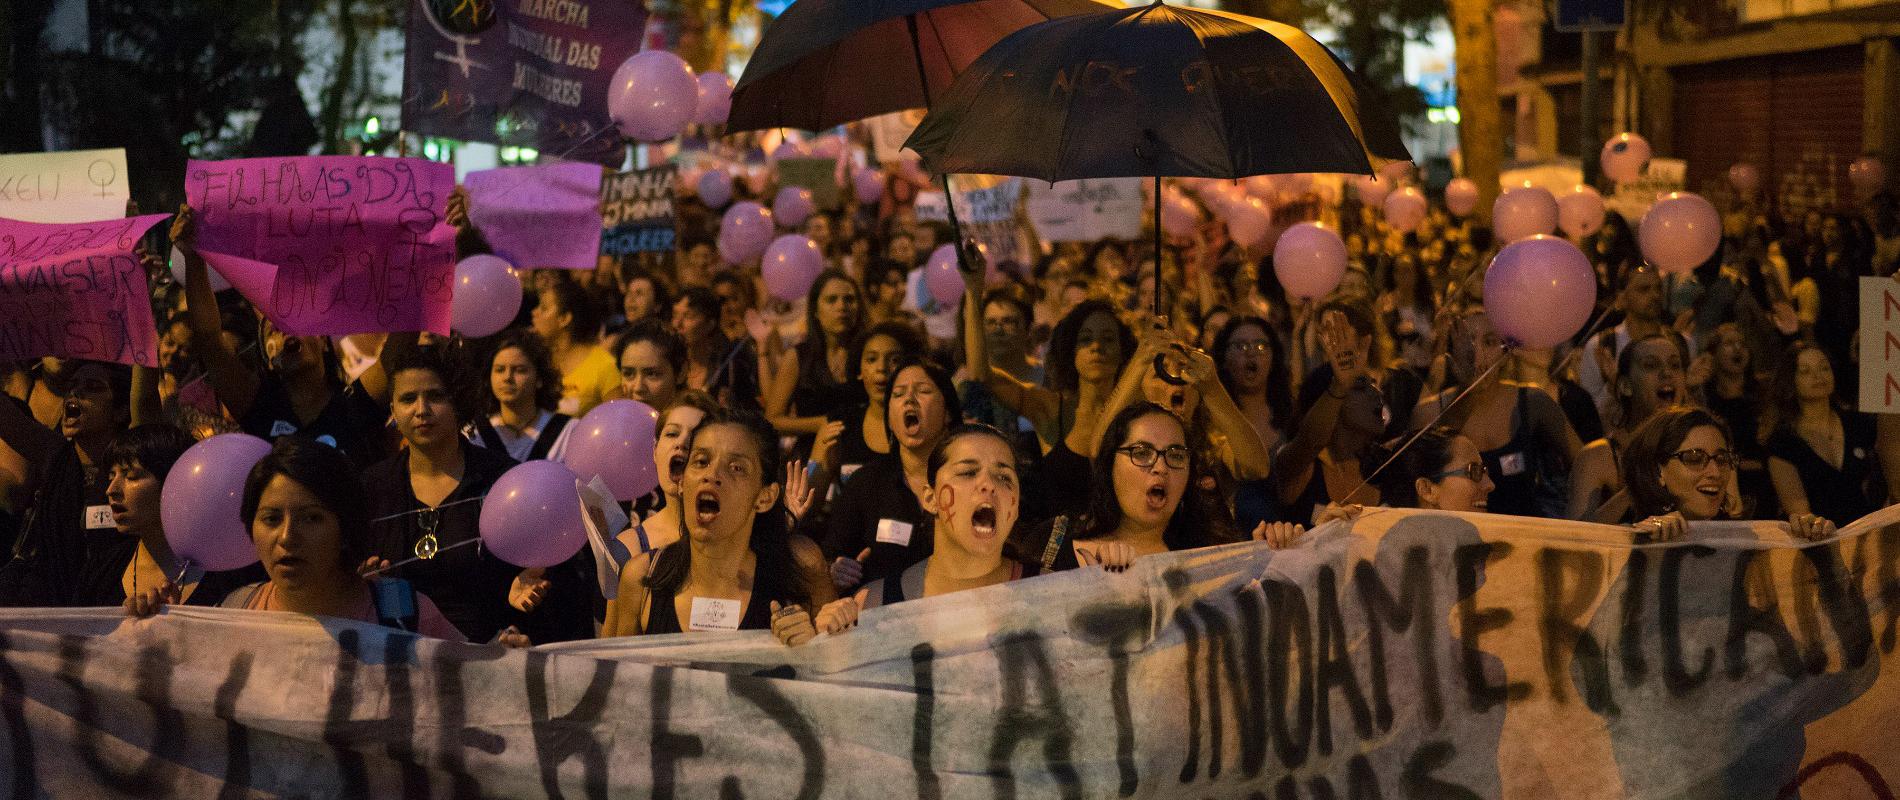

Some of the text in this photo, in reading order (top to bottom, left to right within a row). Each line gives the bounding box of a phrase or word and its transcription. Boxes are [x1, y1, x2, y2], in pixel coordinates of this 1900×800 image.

[518, 0, 589, 29] MARCHA
[565, 40, 603, 71] DAS
[357, 161, 435, 209] DA
[267, 202, 366, 238] LUTA
[63, 254, 136, 299] SER
